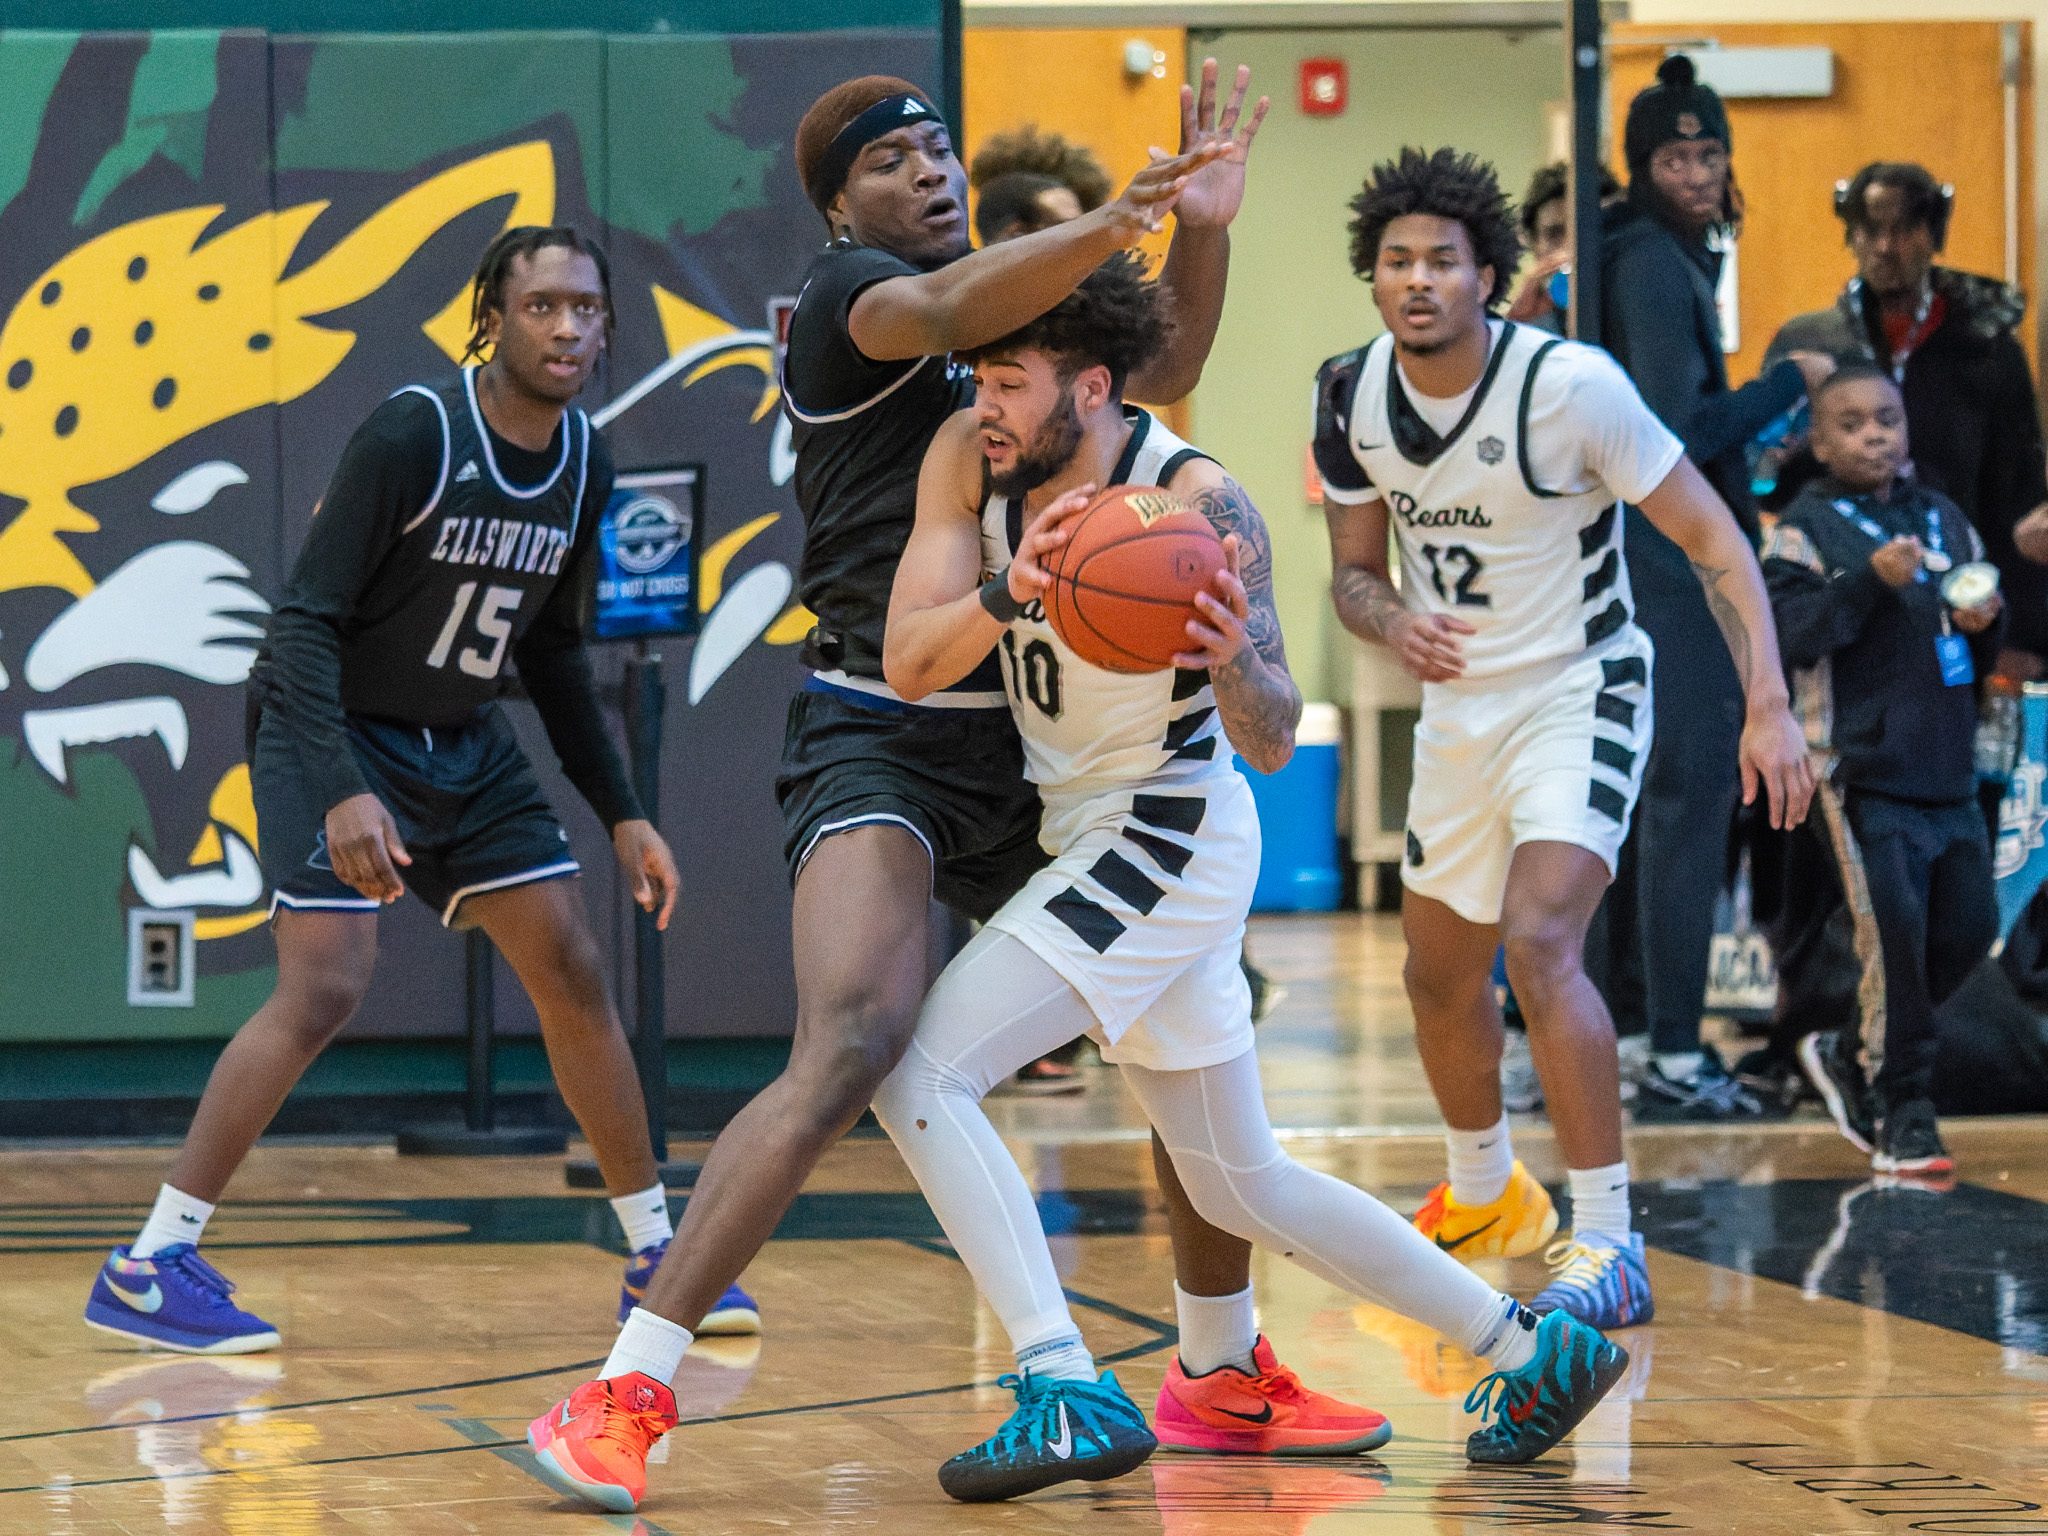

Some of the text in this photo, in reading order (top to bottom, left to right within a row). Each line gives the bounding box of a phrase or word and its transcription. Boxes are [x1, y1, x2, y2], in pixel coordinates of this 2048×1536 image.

[1421, 543, 1491, 606] 12
[426, 580, 525, 679] 15
[1001, 628, 1065, 722] 10
